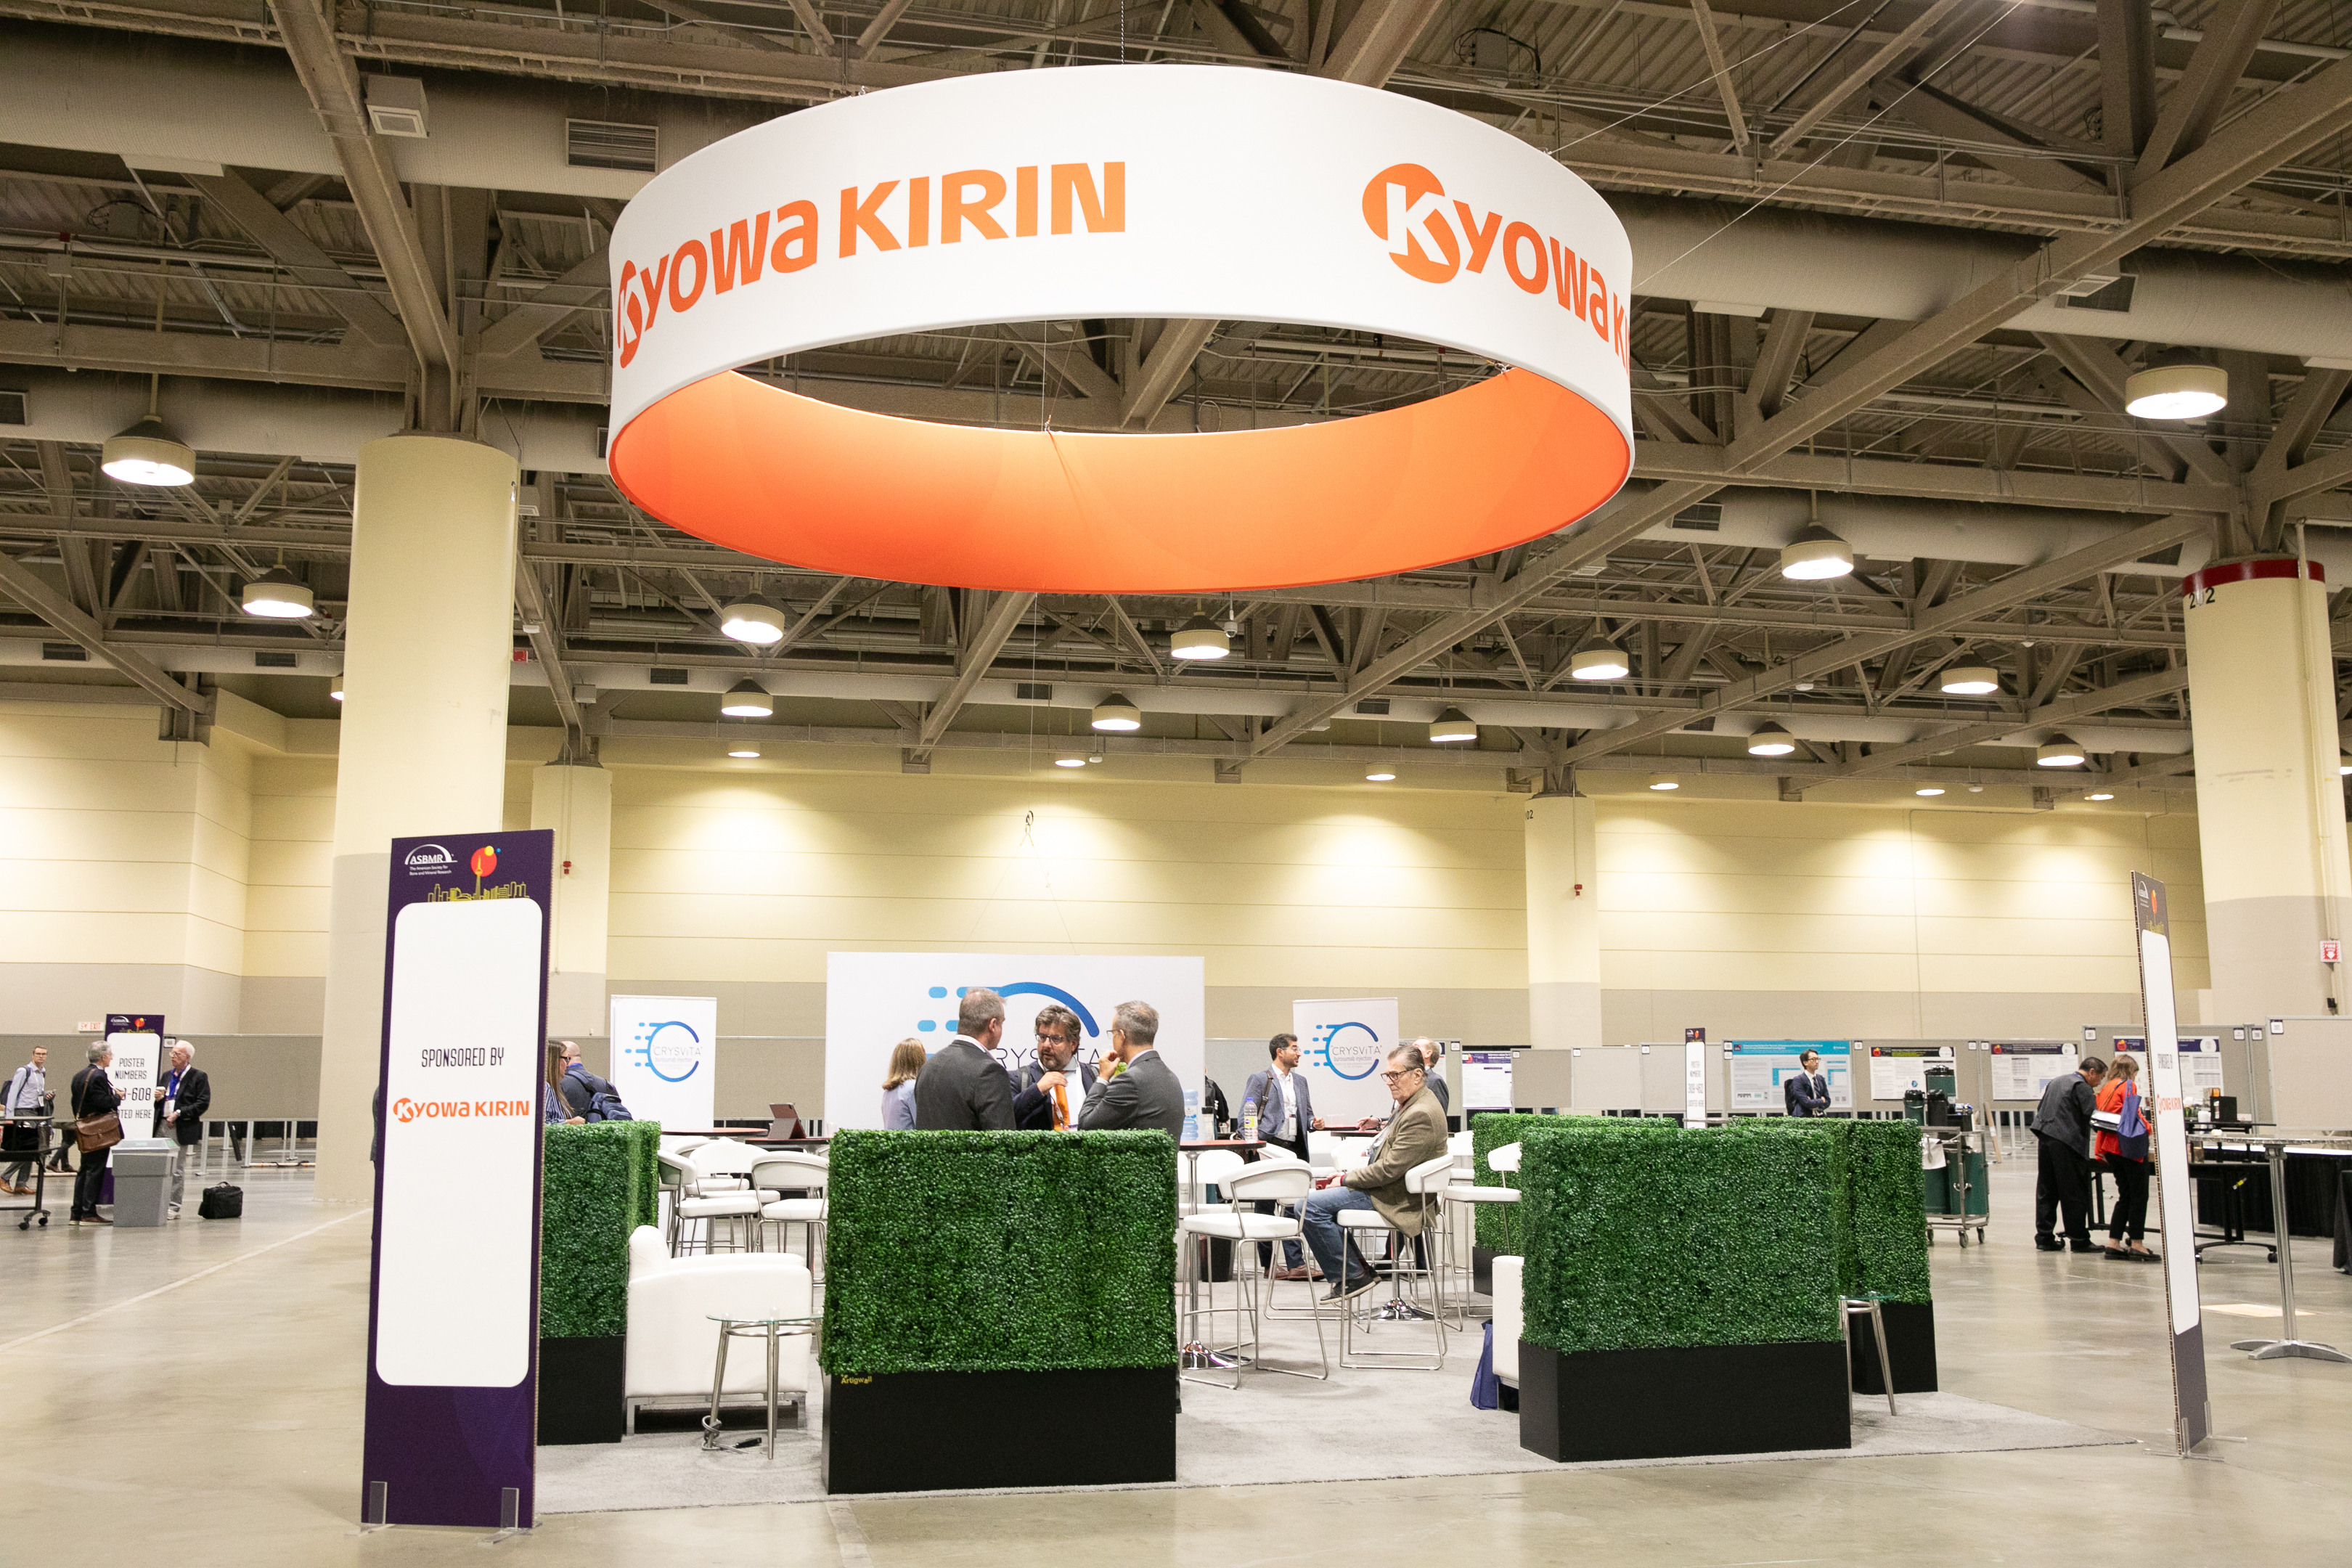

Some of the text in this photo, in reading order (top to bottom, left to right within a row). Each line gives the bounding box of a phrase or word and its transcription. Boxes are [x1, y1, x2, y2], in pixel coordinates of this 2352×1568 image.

[838, 161, 1125, 258] KIRIN
[409, 854, 444, 865] ASBMR
[118, 1058, 145, 1067] POSTER
[422, 1047, 505, 1068] SPONSORED BY
[115, 1070, 147, 1079] NUMBERS
[135, 1109, 152, 1119] HERE
[475, 1101, 529, 1116] KIRIN
